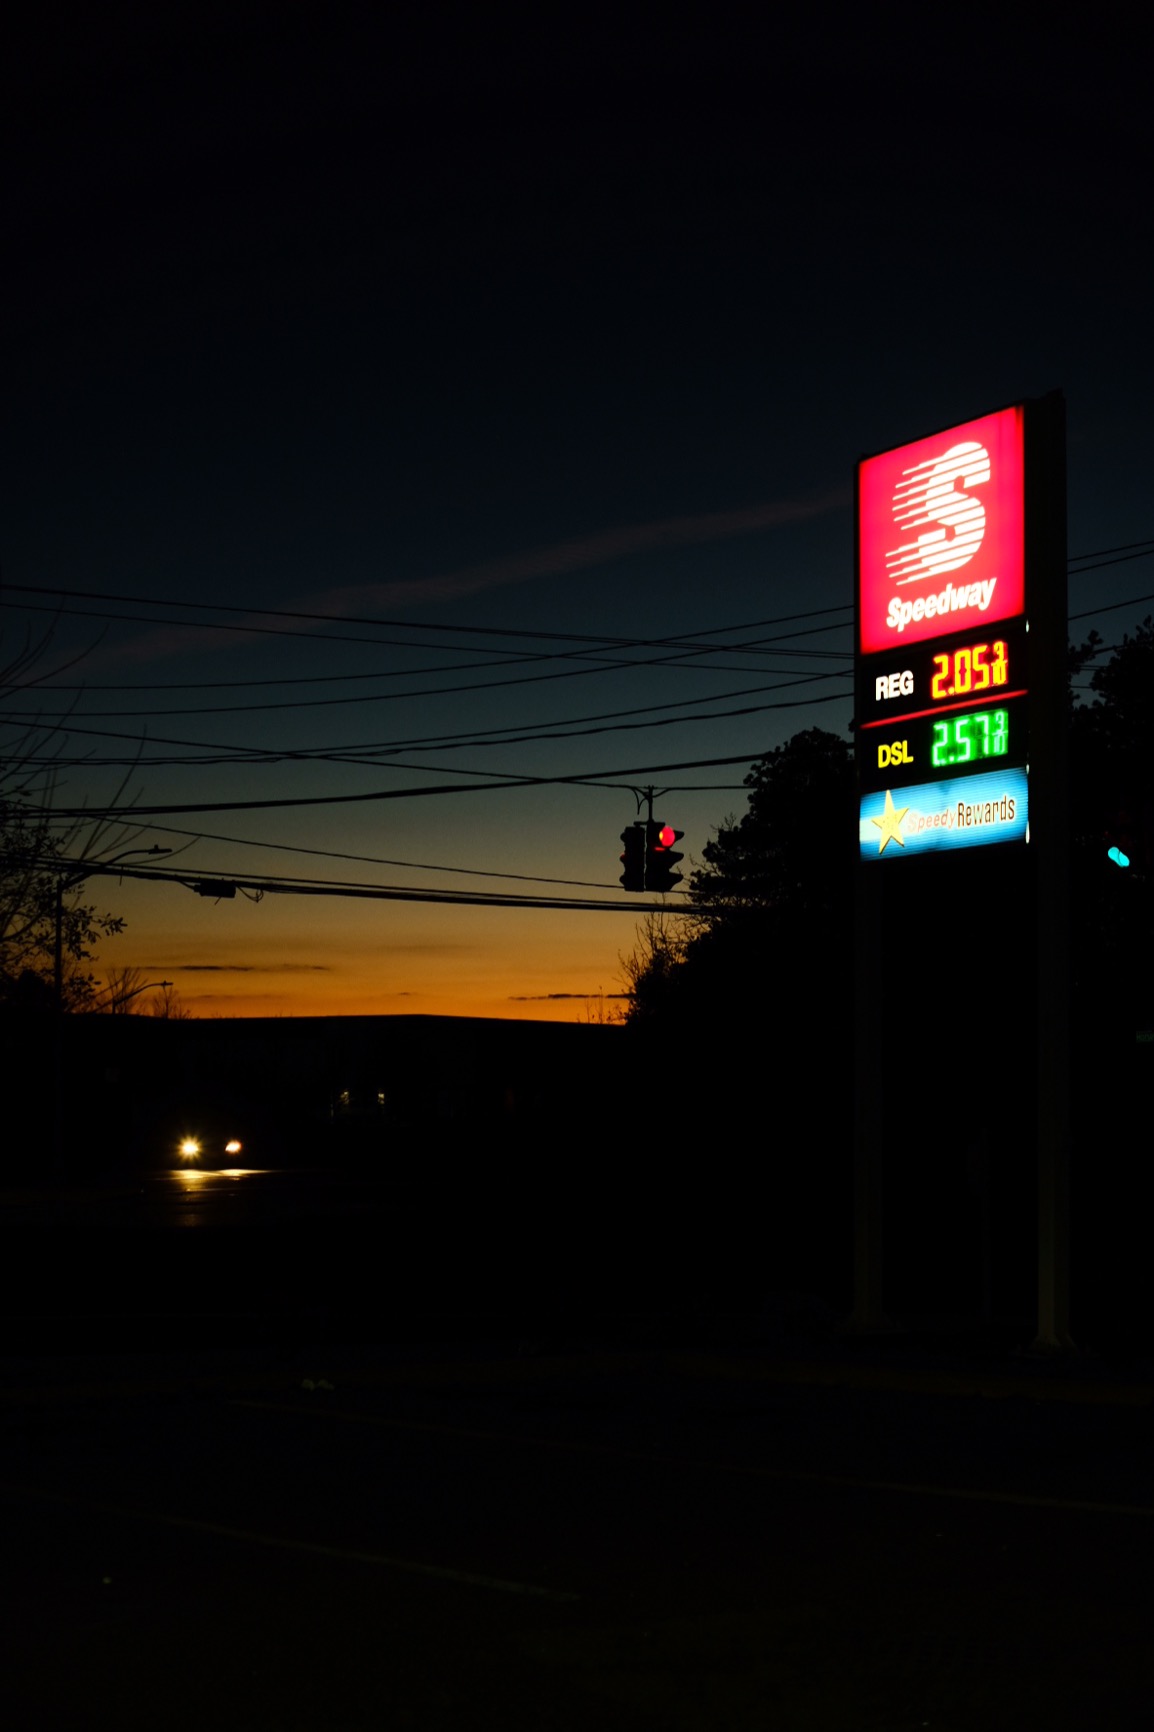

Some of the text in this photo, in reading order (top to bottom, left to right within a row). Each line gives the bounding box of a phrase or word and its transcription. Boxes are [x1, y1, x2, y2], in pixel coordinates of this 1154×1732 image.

[886, 578, 997, 632] Speedway
[875, 670, 914, 701] REG
[877, 740, 914, 768] DSL
